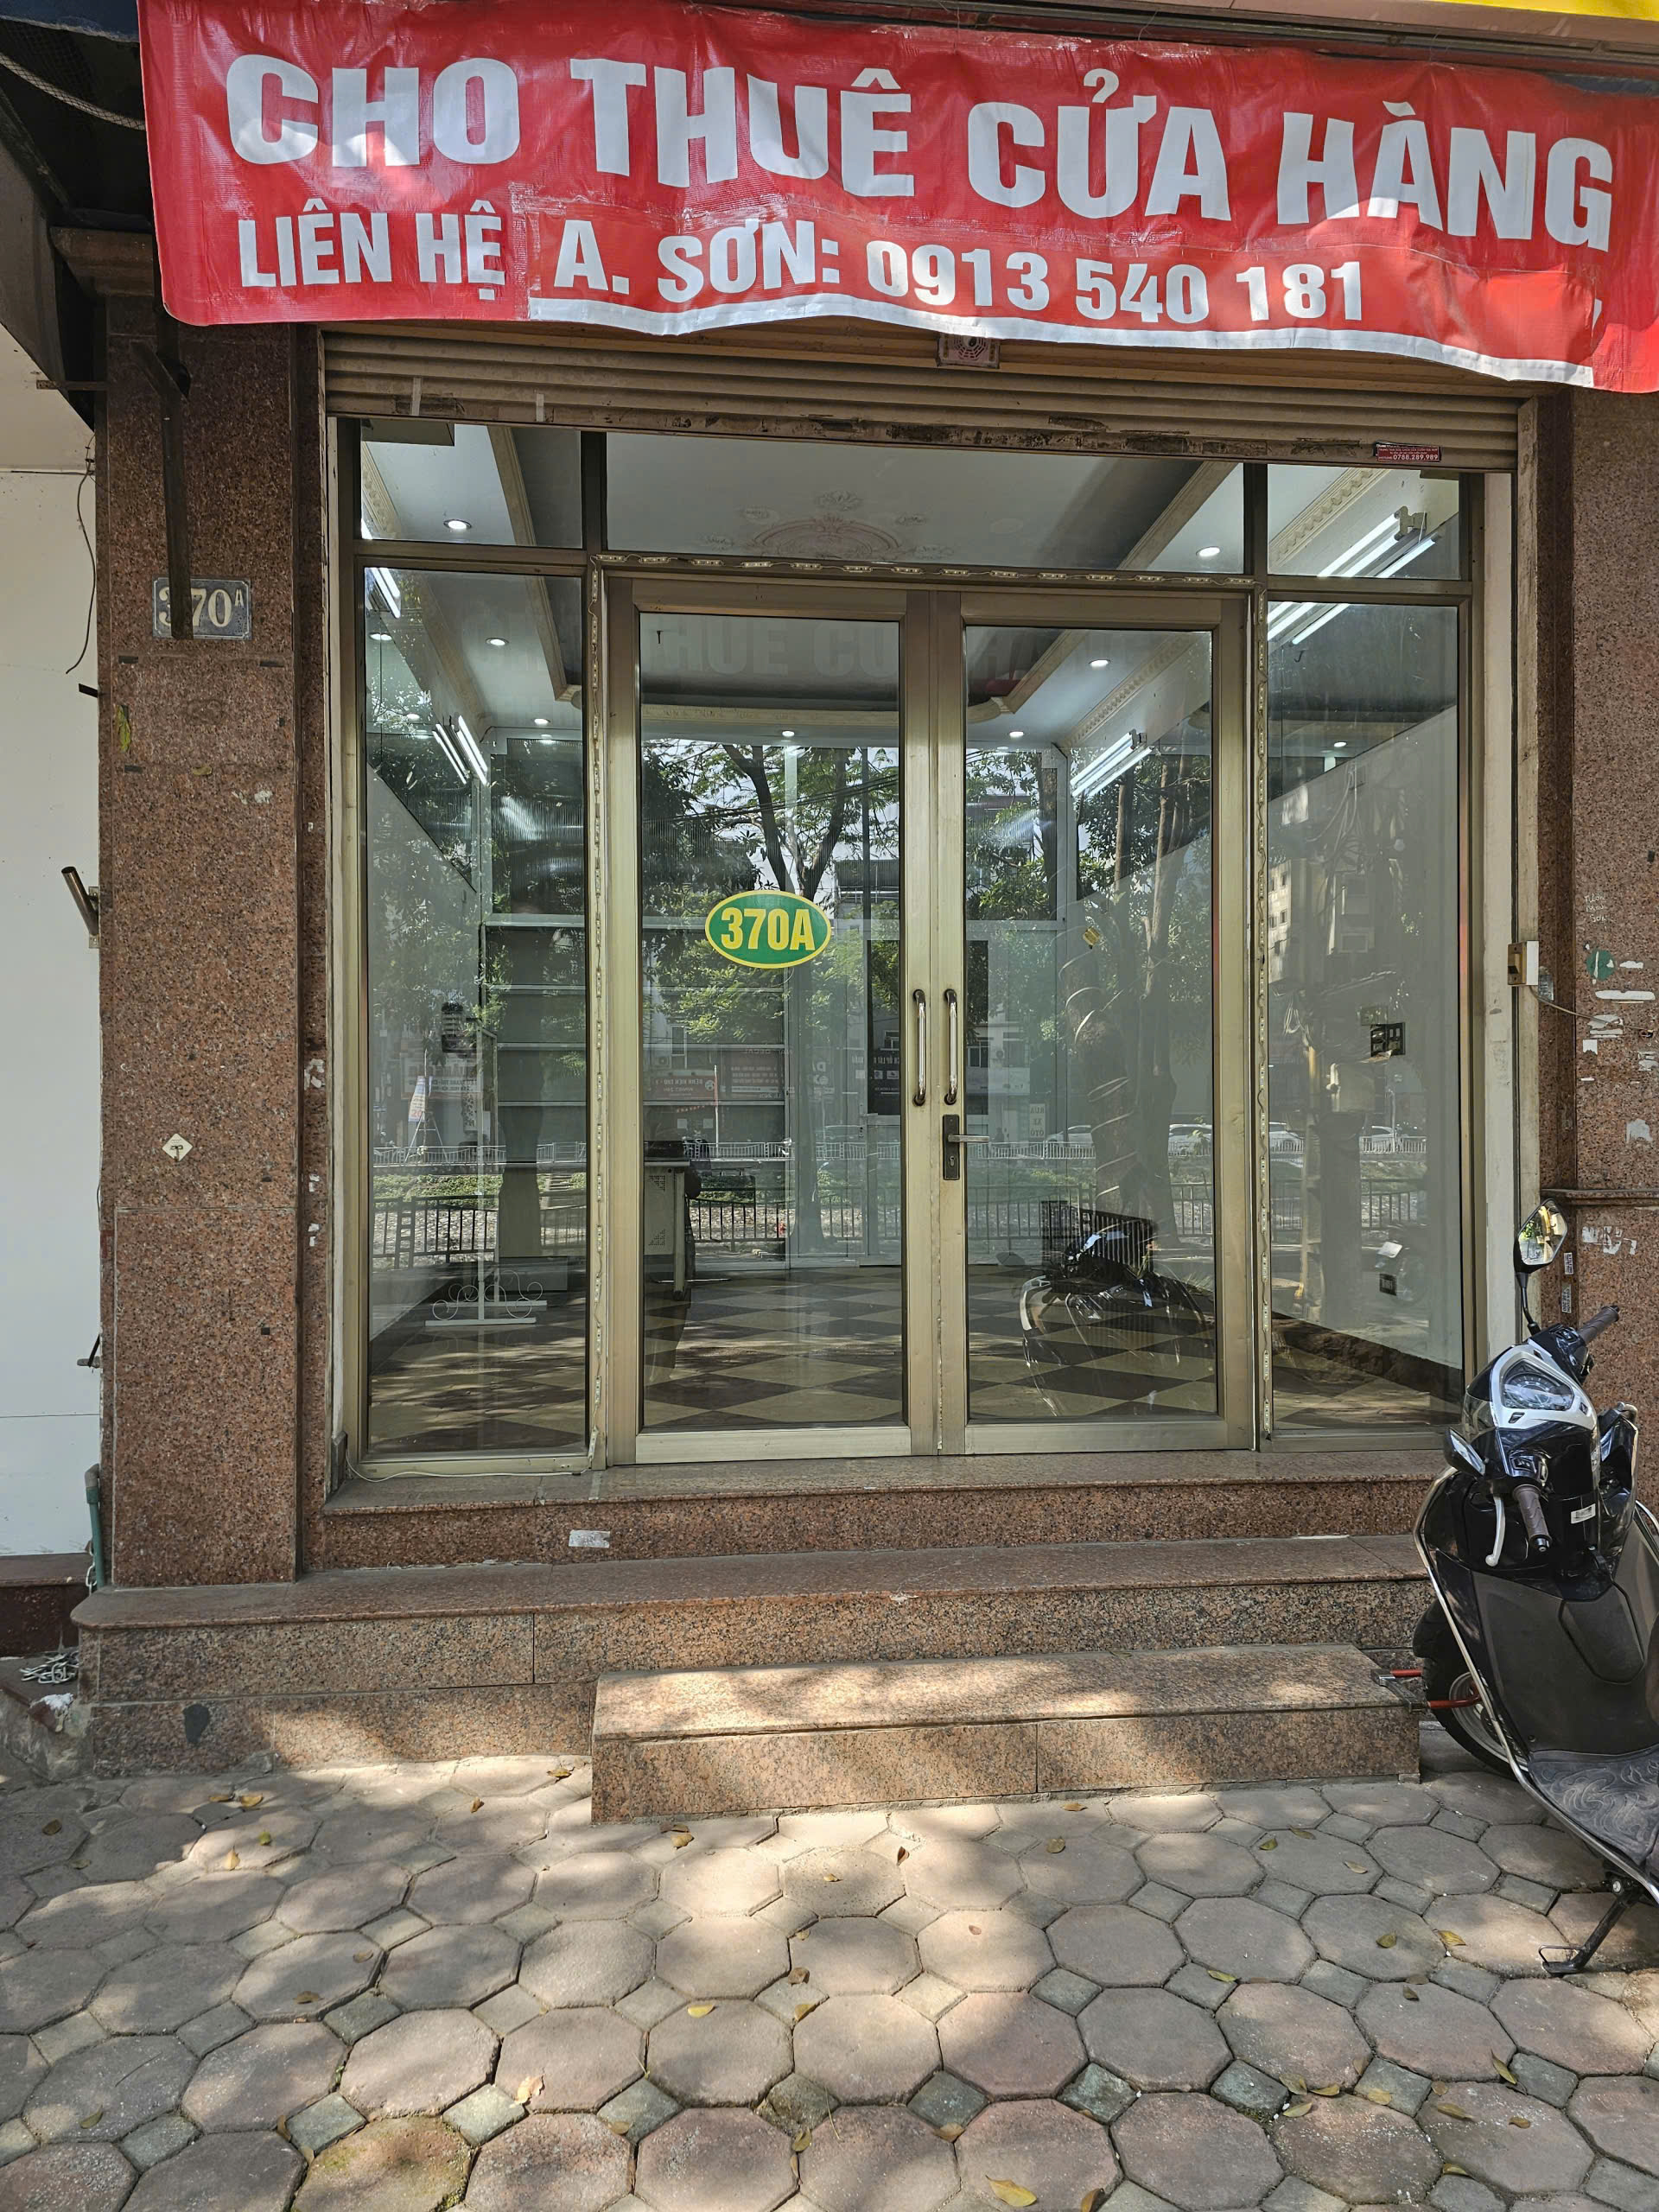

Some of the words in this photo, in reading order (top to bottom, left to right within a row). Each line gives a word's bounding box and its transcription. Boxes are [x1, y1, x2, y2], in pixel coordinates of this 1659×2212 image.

[226, 54, 520, 168] CHO
[570, 58, 914, 198] THUÊ
[969, 68, 1231, 222] CỬA
[1277, 101, 1613, 251] HÀNG
[238, 199, 393, 289] LIÊN
[416, 200, 505, 301] HỆ
[554, 219, 630, 294] A.
[657, 217, 840, 303] SƠN:
[867, 240, 1050, 311] 0913
[1076, 259, 1209, 324] 540
[1236, 261, 1363, 322] 181
[721, 906, 816, 950] 370A
